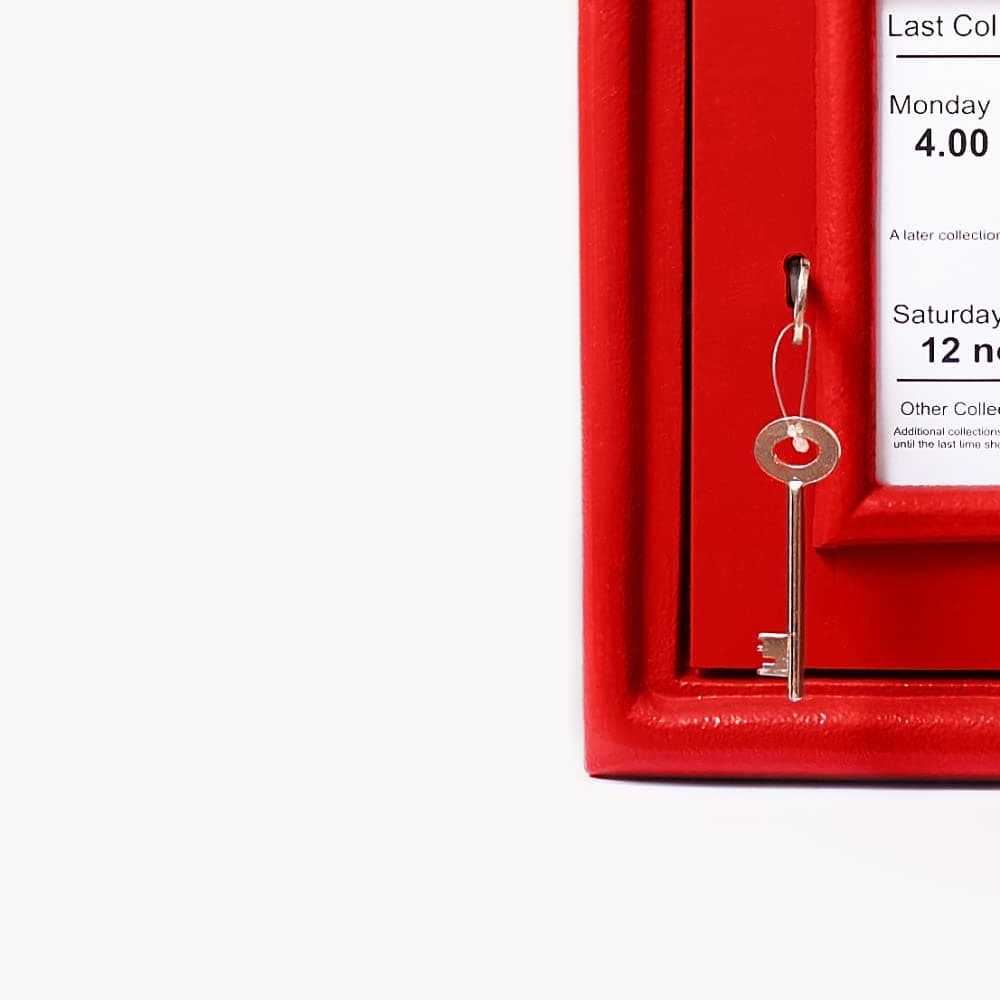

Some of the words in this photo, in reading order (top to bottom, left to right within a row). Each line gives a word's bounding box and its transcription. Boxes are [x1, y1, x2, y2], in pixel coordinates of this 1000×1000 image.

[888, 13, 944, 38] Last
[889, 94, 991, 121] Monday
[914, 127, 989, 158] 4.00
[889, 228, 900, 241] A
[903, 229, 934, 241] later
[921, 336, 961, 364] 12
[900, 400, 949, 416] Other
[893, 426, 945, 437] Additional
[893, 439, 915, 449] until
[917, 439, 935, 449] the
[937, 439, 956, 449] last
[959, 439, 981, 449] time
